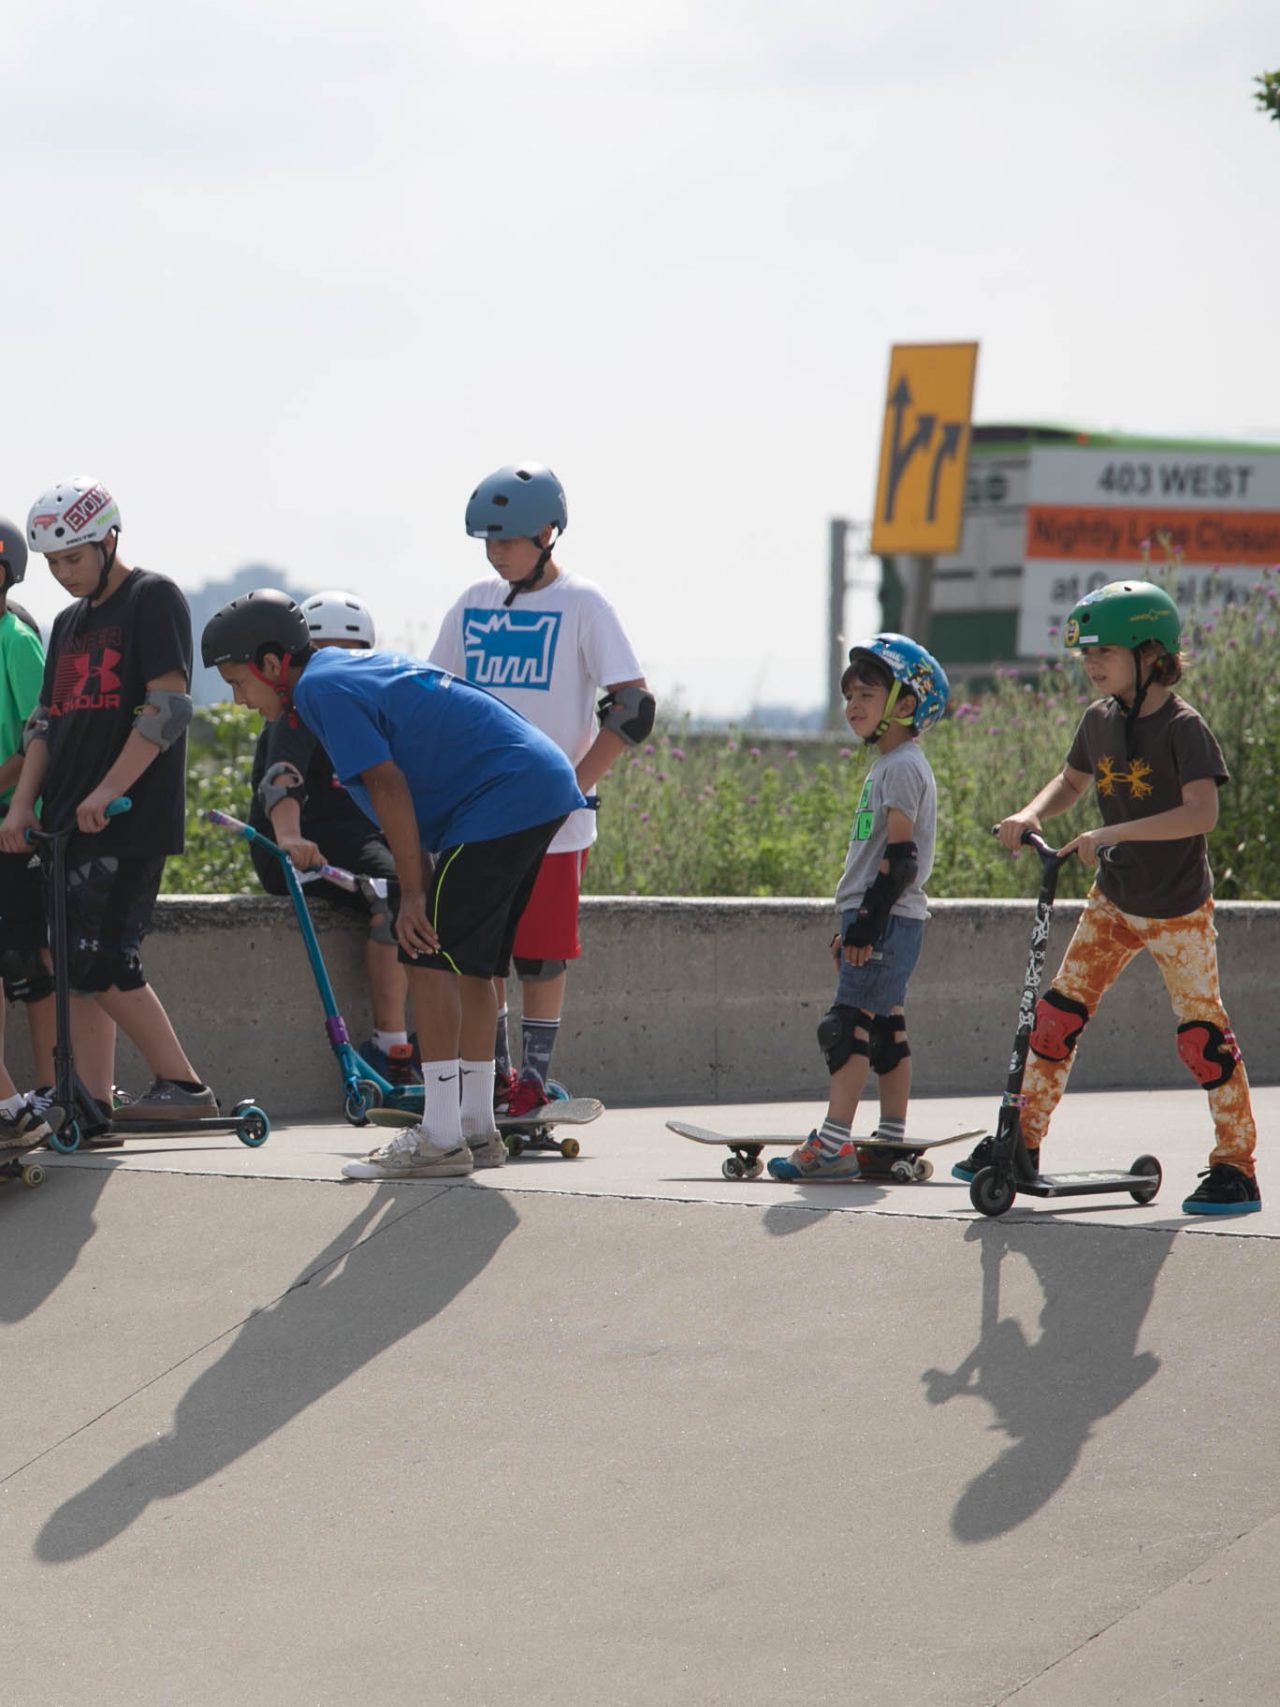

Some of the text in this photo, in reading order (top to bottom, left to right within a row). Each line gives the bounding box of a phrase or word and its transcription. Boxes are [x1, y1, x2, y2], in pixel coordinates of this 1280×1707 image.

[1097, 462, 1252, 497] 403 WEST
[1033, 513, 1118, 554] Nightly
